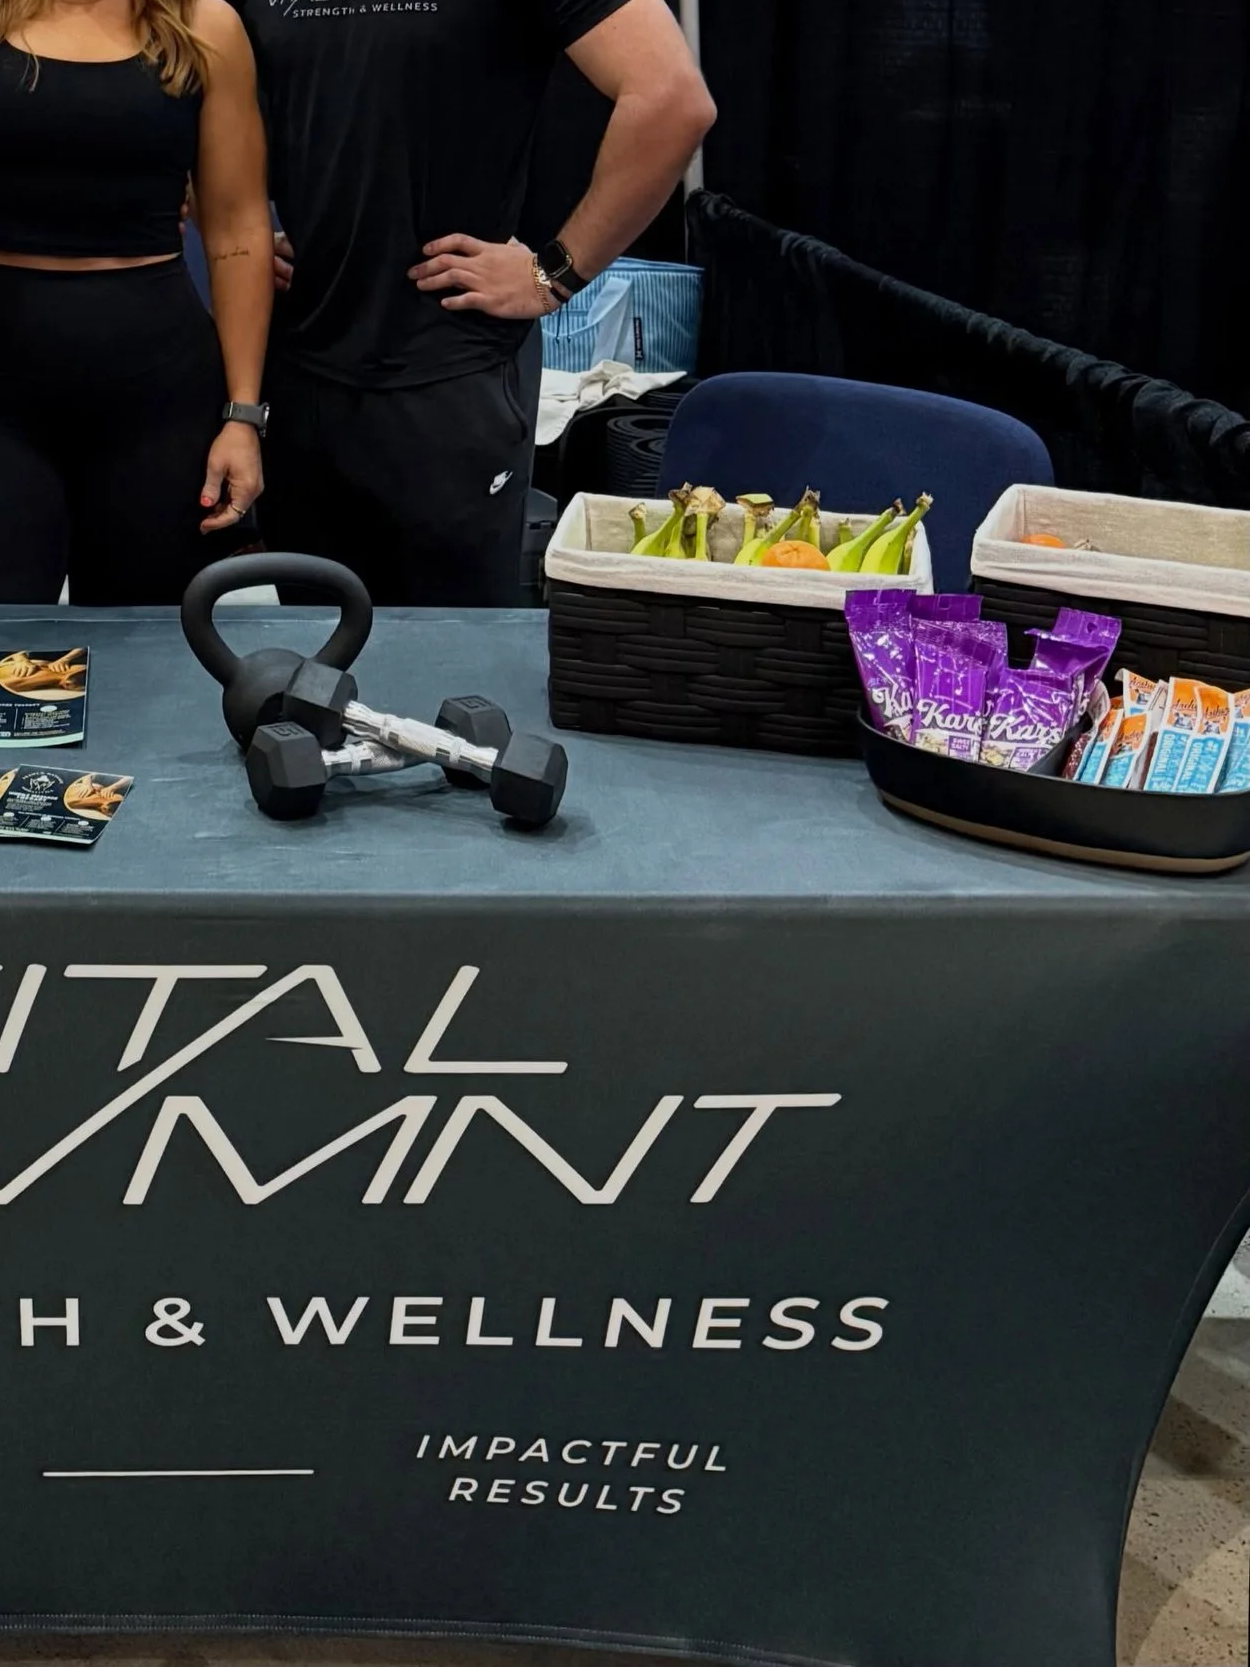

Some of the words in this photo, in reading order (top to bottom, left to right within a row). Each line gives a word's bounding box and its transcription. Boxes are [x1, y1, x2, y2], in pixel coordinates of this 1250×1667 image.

[292, 6, 355, 19] STRENGTH
[359, 5, 367, 14] &
[372, 1, 438, 13] WELLNESS
[990, 712, 1063, 746] Kar's
[145, 1295, 206, 1348] &
[266, 1294, 891, 1351] WELLNESS
[416, 1435, 728, 1473] IMPACTFUL
[448, 1476, 688, 1515] RESULTS
